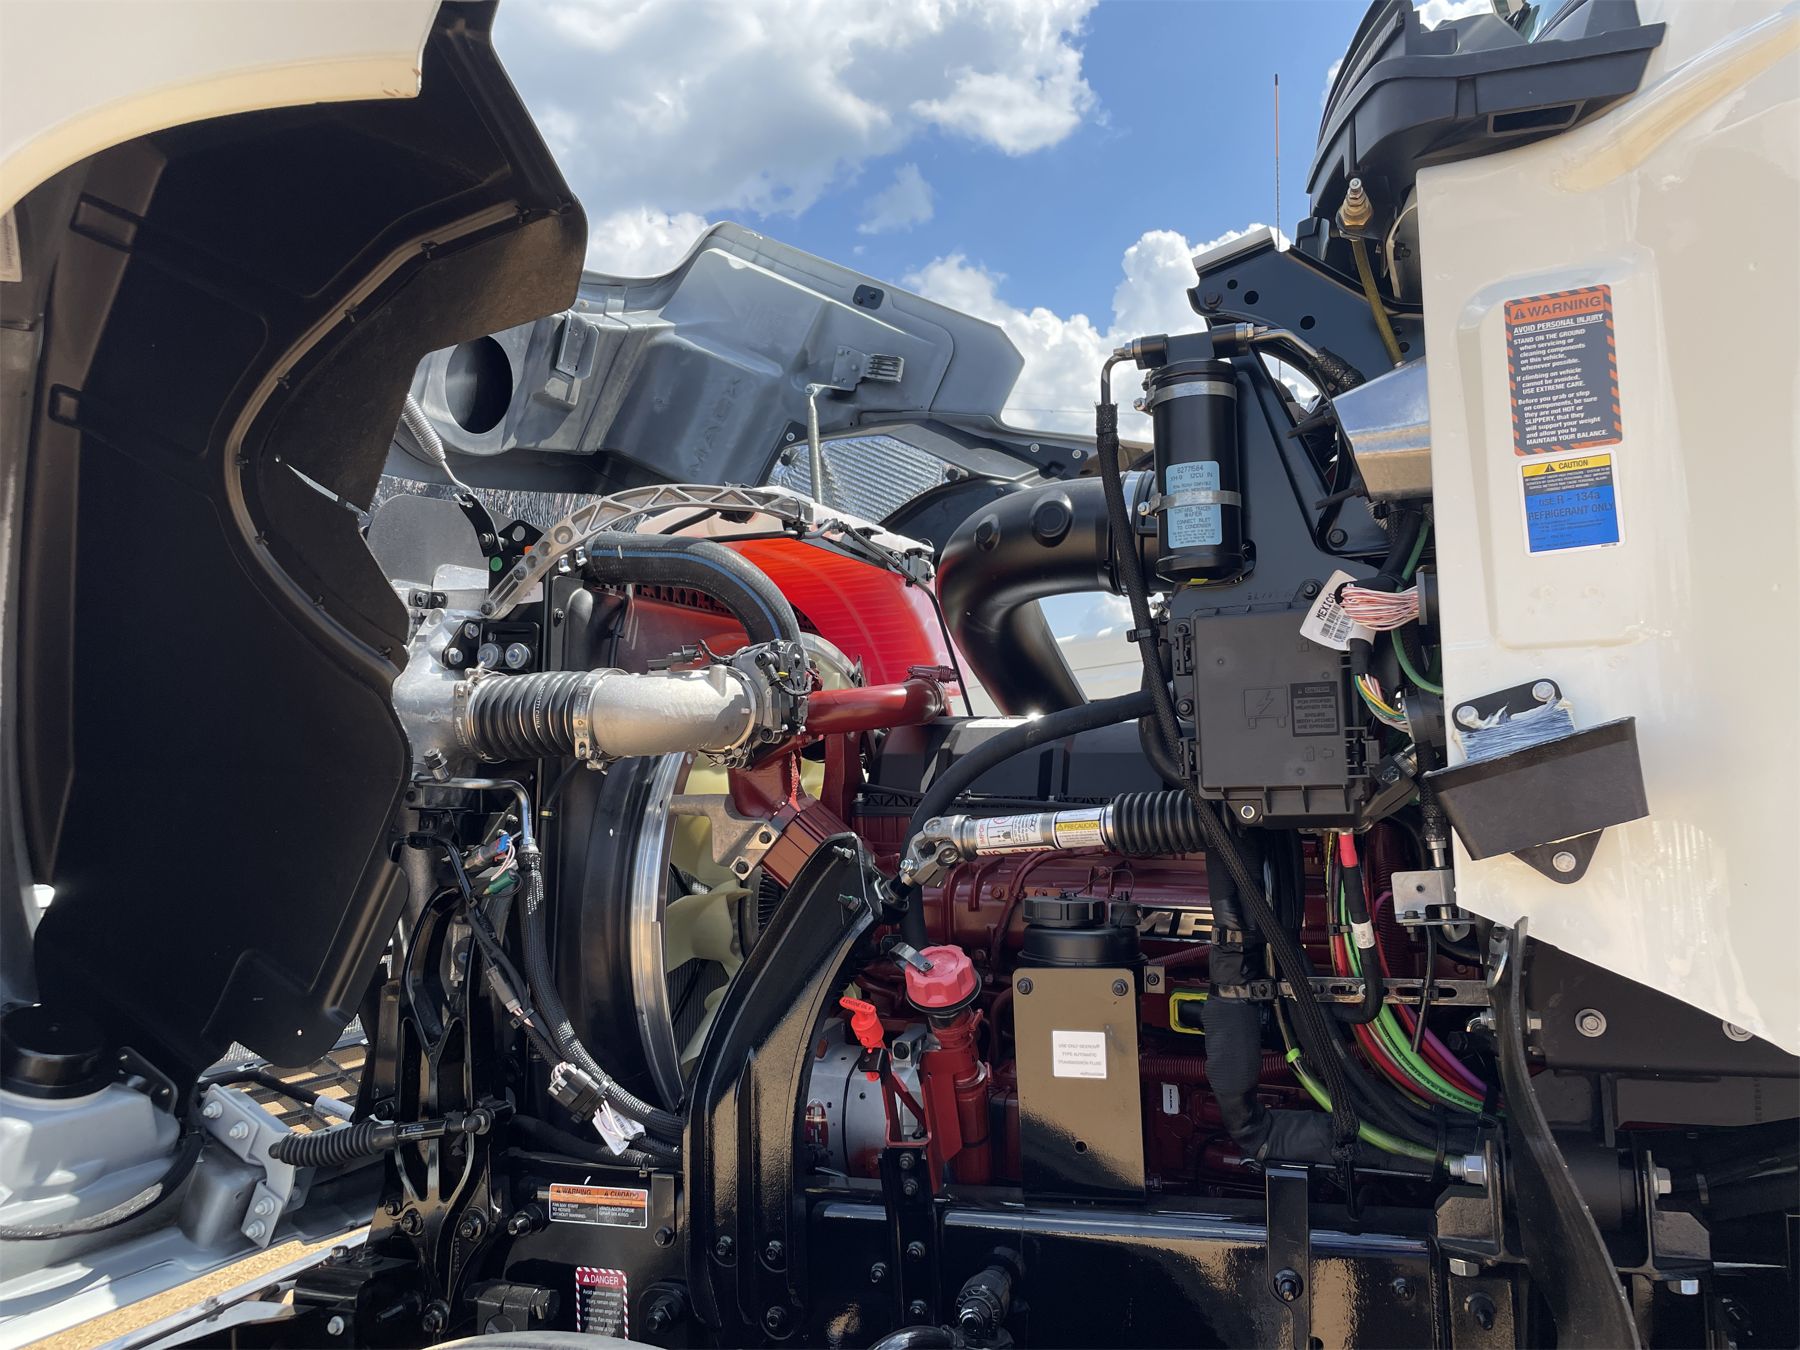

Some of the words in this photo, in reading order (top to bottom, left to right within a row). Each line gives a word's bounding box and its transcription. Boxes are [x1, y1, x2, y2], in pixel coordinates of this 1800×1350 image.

[1528, 296, 1600, 317] WARNING
[1514, 325, 1535, 334] AVOID
[1537, 318, 1574, 330] PERSONAL
[1576, 313, 1603, 323] INJURY
[1559, 329, 1586, 338] GROUND
[1538, 340, 1566, 348] servicing
[1520, 350, 1546, 358] cleaning
[1547, 344, 1586, 354] components
[1521, 363, 1551, 371] whenever
[1552, 358, 1580, 367] possible.
[1522, 372, 1548, 380] climbing
[1536, 383, 1565, 392] EXTREME
[1533, 400, 1572, 409] components,
[1525, 416, 1555, 425] SLIPPERY,
[1538, 422, 1562, 430] support
[1526, 436, 1557, 445] MAINTAIN
[1577, 429, 1608, 438] BALANCE.
[1559, 460, 1588, 469] CAUTION
[1557, 495, 1564, 503] R
[1576, 491, 1600, 501] 134a
[1528, 506, 1588, 520] REFRIGERANT
[1591, 503, 1615, 513] ONLY
[1316, 593, 1335, 620] MEXICO
[591, 1275, 618, 1285] DANGER
